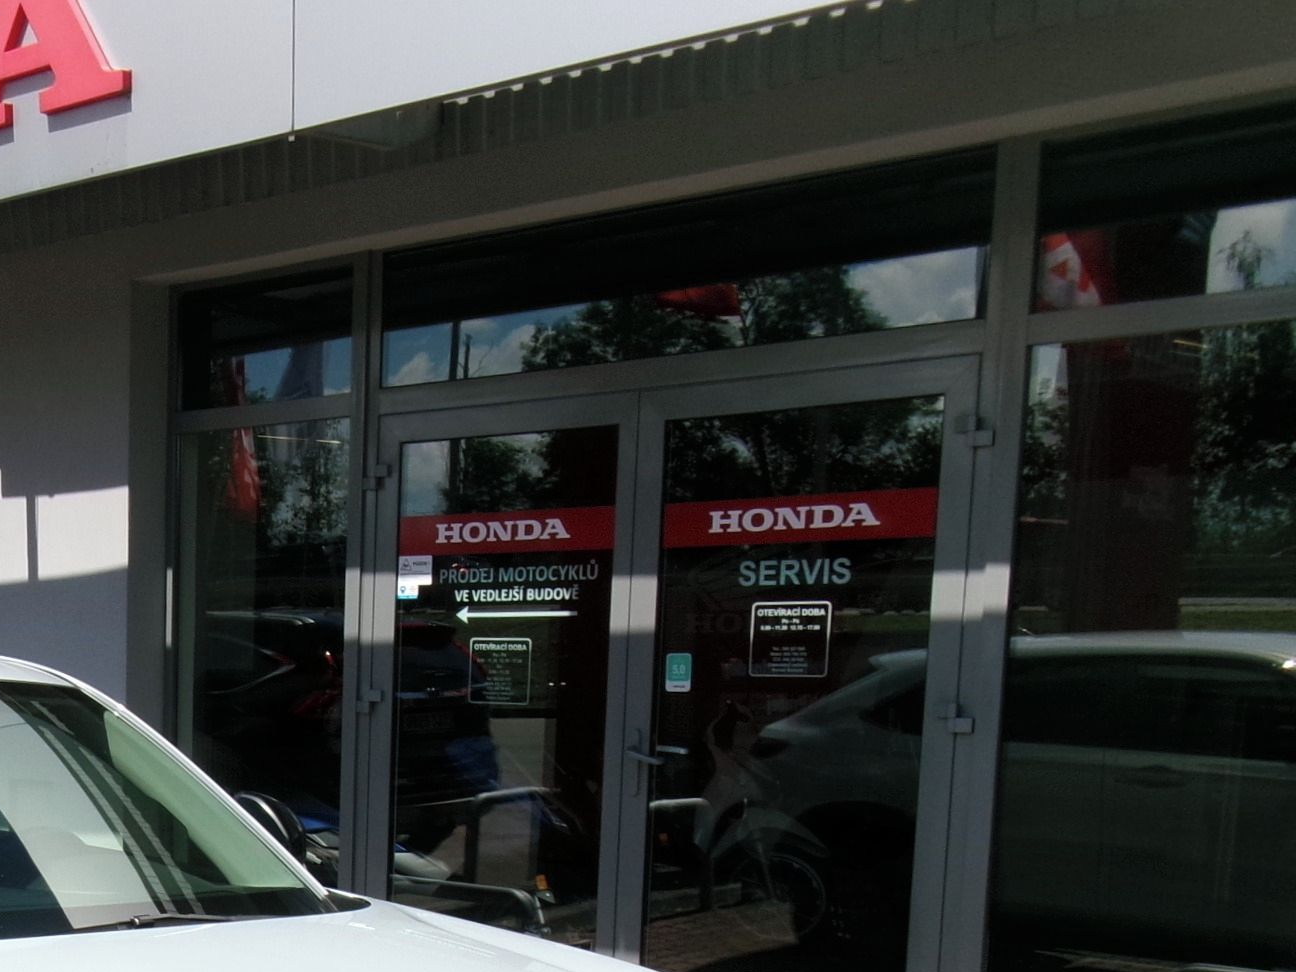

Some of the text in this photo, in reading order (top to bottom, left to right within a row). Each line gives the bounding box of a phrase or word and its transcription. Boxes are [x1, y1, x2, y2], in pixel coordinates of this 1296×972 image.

[708, 503, 880, 533] HONDA
[435, 518, 570, 544] HONDA
[439, 559, 599, 584] PRODEJ MOTOCYKLŮ
[738, 557, 852, 587] SERVIS
[455, 584, 579, 602] VE VEDLEJŠÍ BUDOVĚ
[757, 607, 826, 617] OTEVÍRACÍ DOBA
